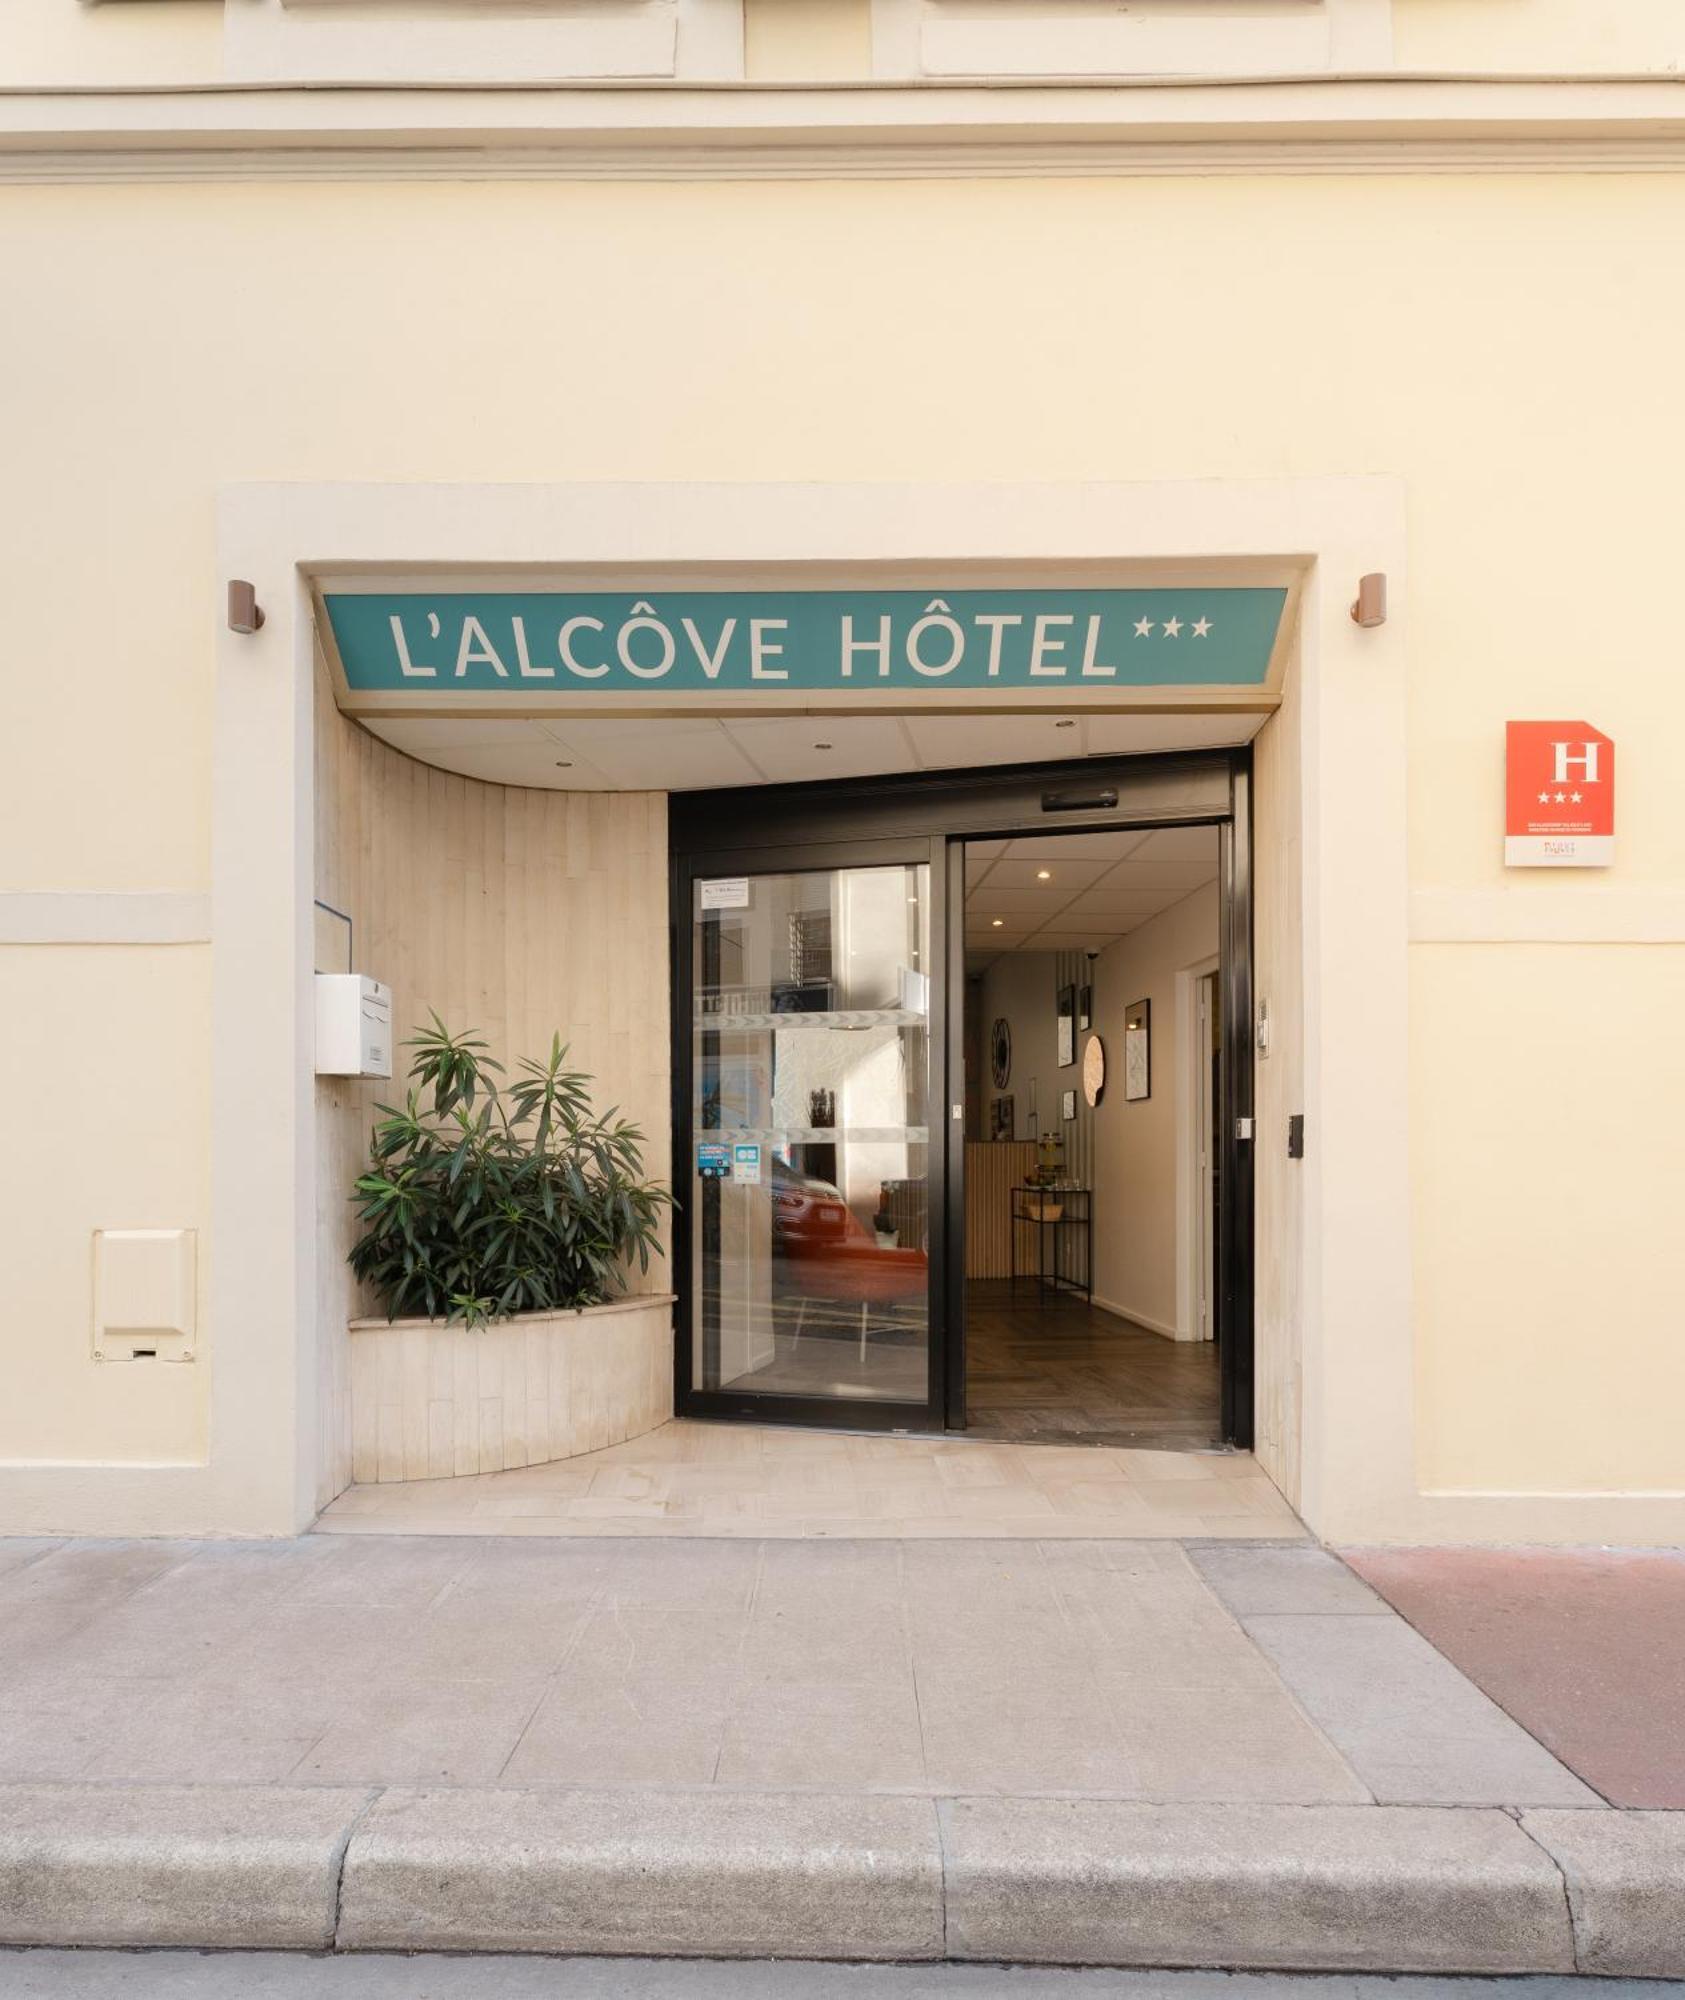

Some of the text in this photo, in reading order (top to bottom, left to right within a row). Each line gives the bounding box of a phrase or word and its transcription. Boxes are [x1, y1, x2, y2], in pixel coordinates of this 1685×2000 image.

[388, 599, 1117, 680] L'ALCÔVE HÔTEL
[1550, 741, 1604, 783] H
